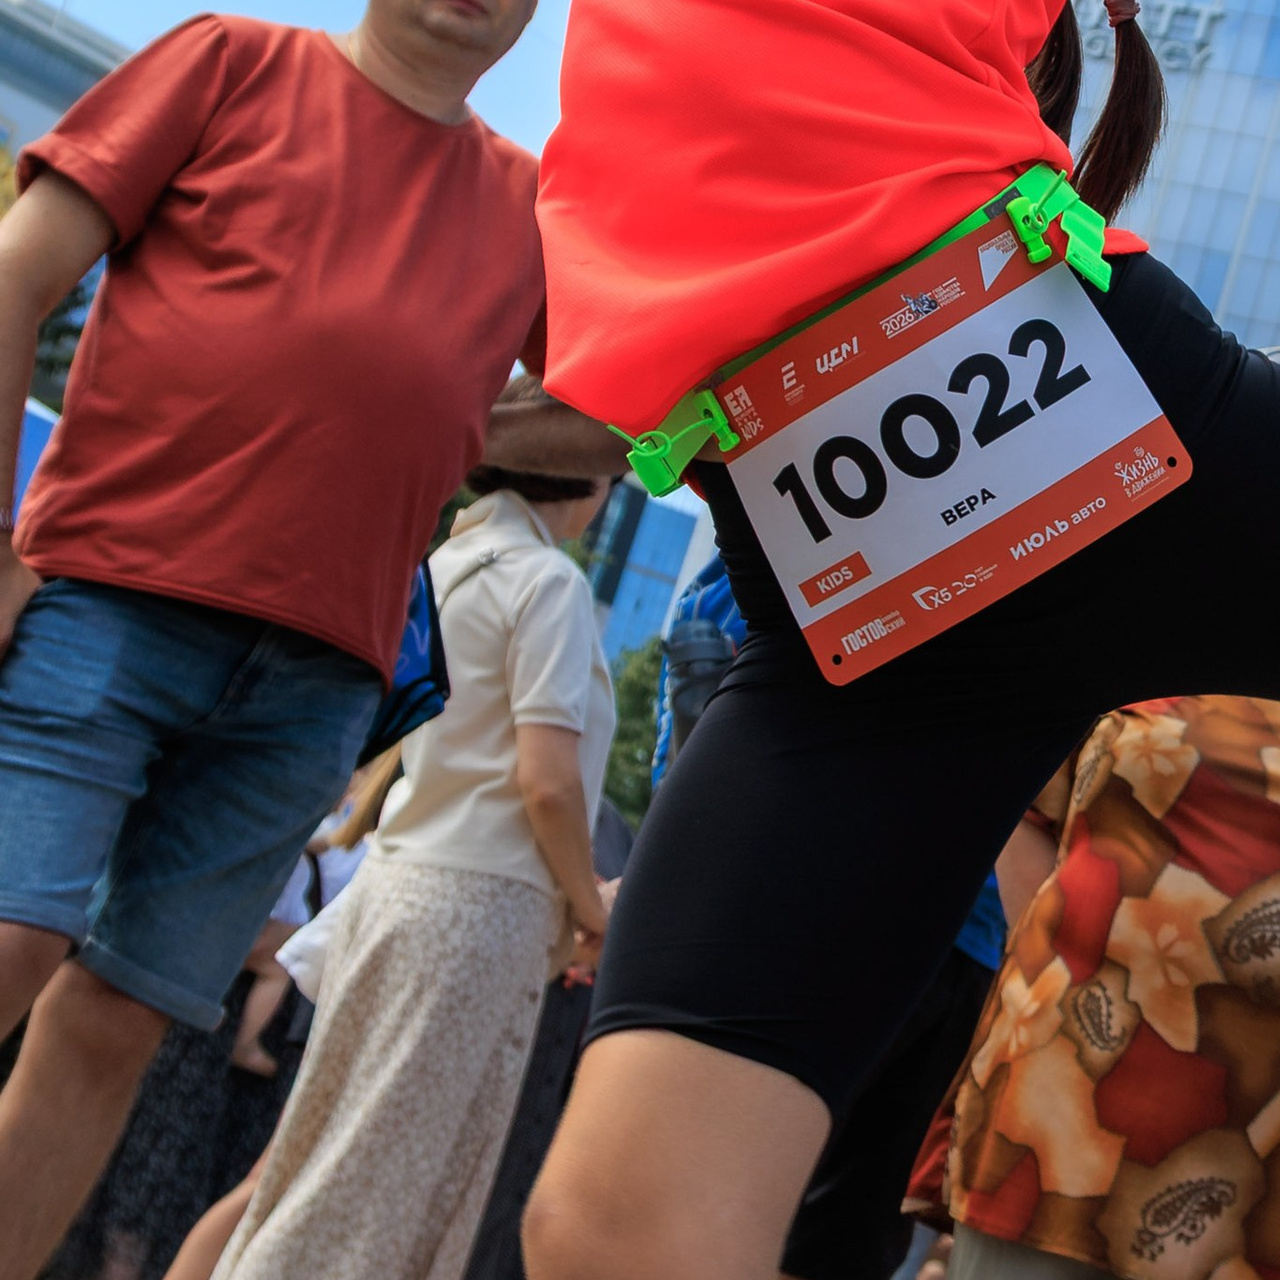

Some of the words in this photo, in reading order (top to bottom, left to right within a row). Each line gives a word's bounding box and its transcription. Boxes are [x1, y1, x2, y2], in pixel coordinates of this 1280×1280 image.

[881, 309, 915, 336] 2026
[772, 318, 1092, 544] 10022
[1114, 452, 1160, 487] ЖИЗНЬ
[940, 487, 997, 527] ВЕРА
[1009, 520, 1069, 561] ИЮЛЬ
[1071, 497, 1107, 525] авто
[816, 566, 854, 594] KIDS
